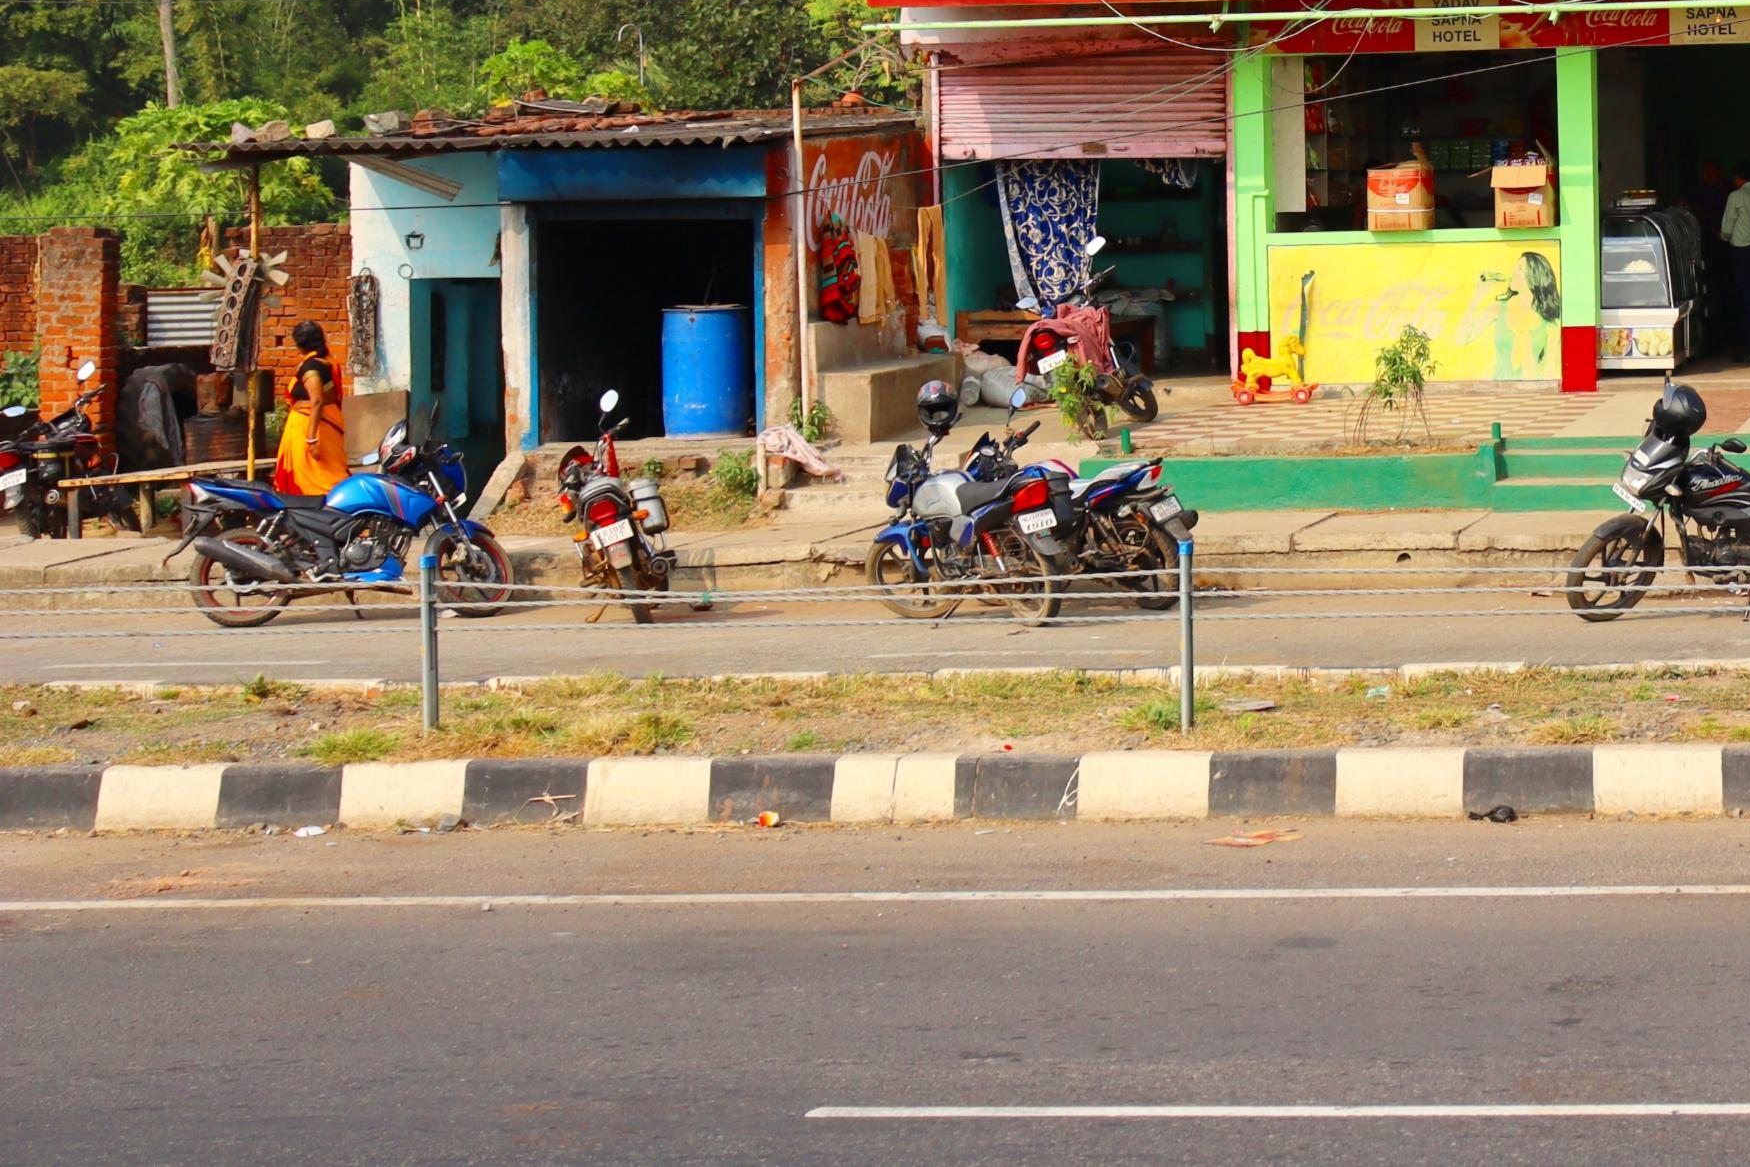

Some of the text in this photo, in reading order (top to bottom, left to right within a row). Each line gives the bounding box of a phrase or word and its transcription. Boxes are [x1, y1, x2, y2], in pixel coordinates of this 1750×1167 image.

[1686, 6, 1737, 20] SAPNA
[1687, 23, 1737, 36] HOTEL
[1432, 30, 1482, 43] HOTEL
